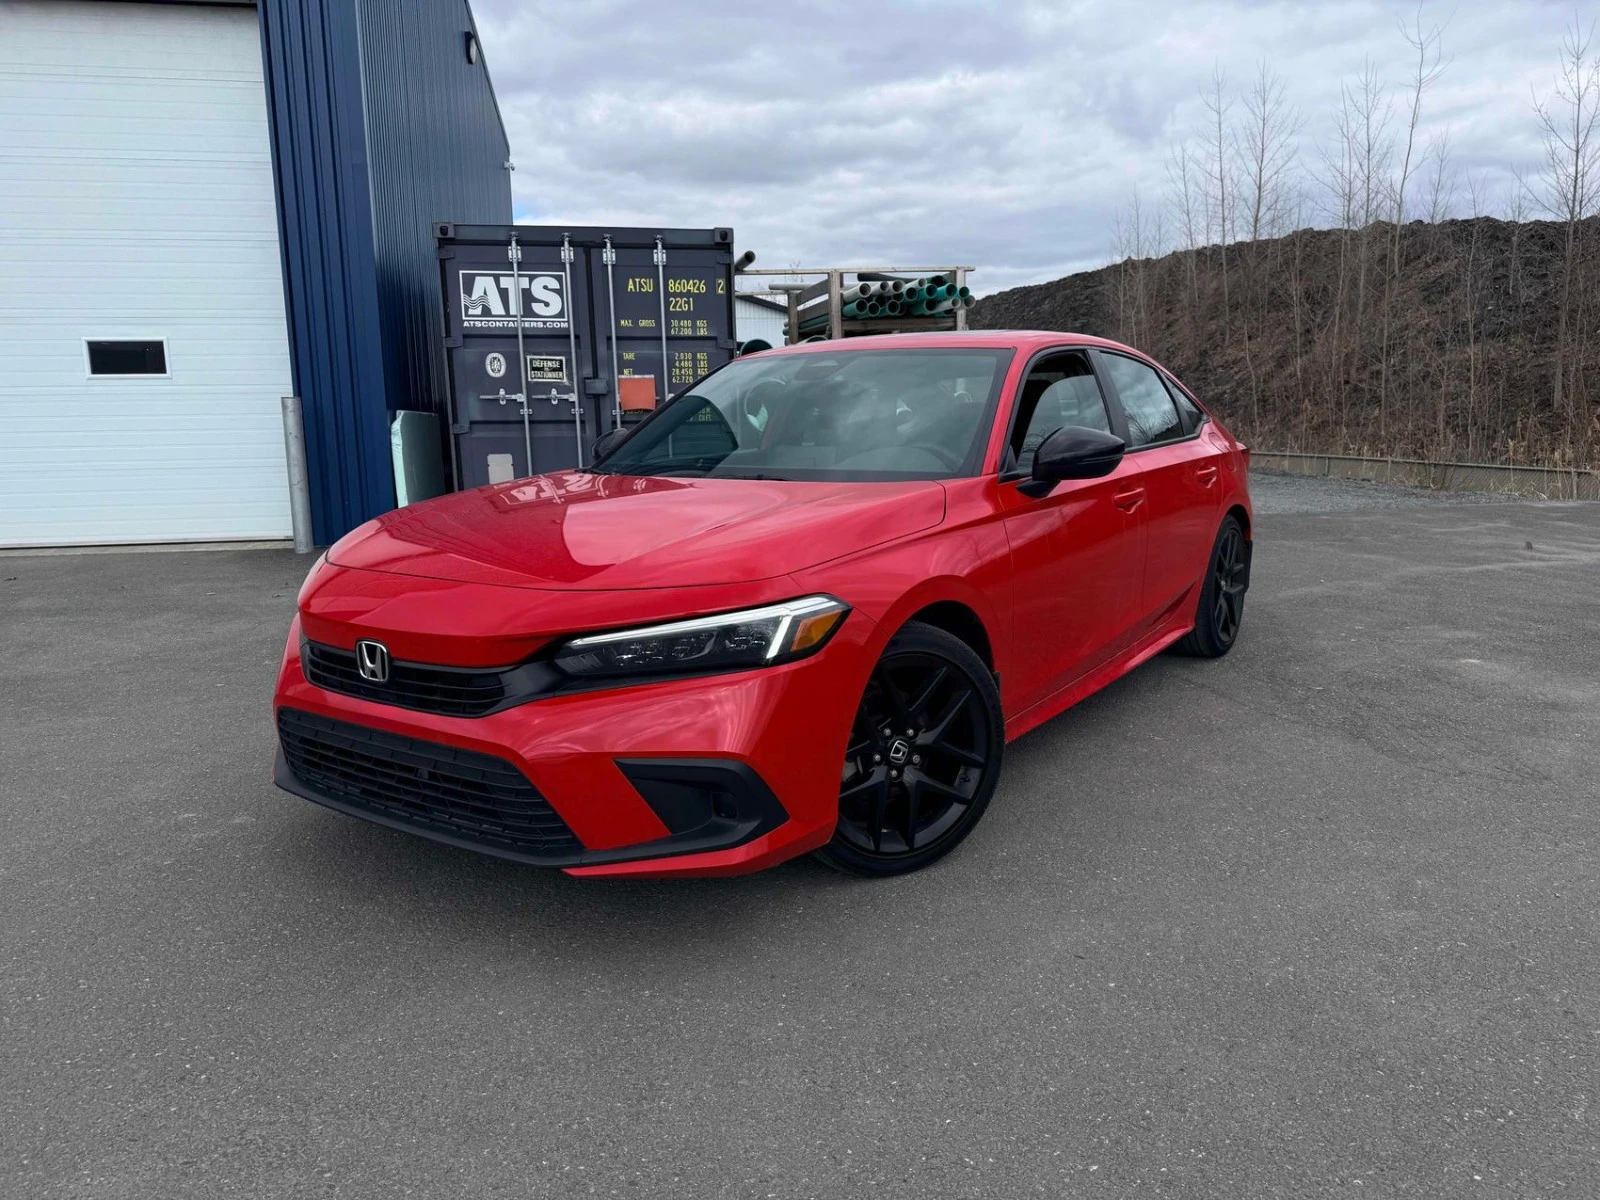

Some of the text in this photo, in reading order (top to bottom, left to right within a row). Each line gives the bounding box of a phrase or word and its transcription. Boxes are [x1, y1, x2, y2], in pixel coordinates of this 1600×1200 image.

[627, 278, 724, 293] ATSU 860426 2
[464, 276, 562, 316] ATS
[669, 297, 694, 311] 22G1
[638, 319, 655, 327] GROSS
[622, 352, 636, 360] TARE
[623, 368, 633, 376] NET
